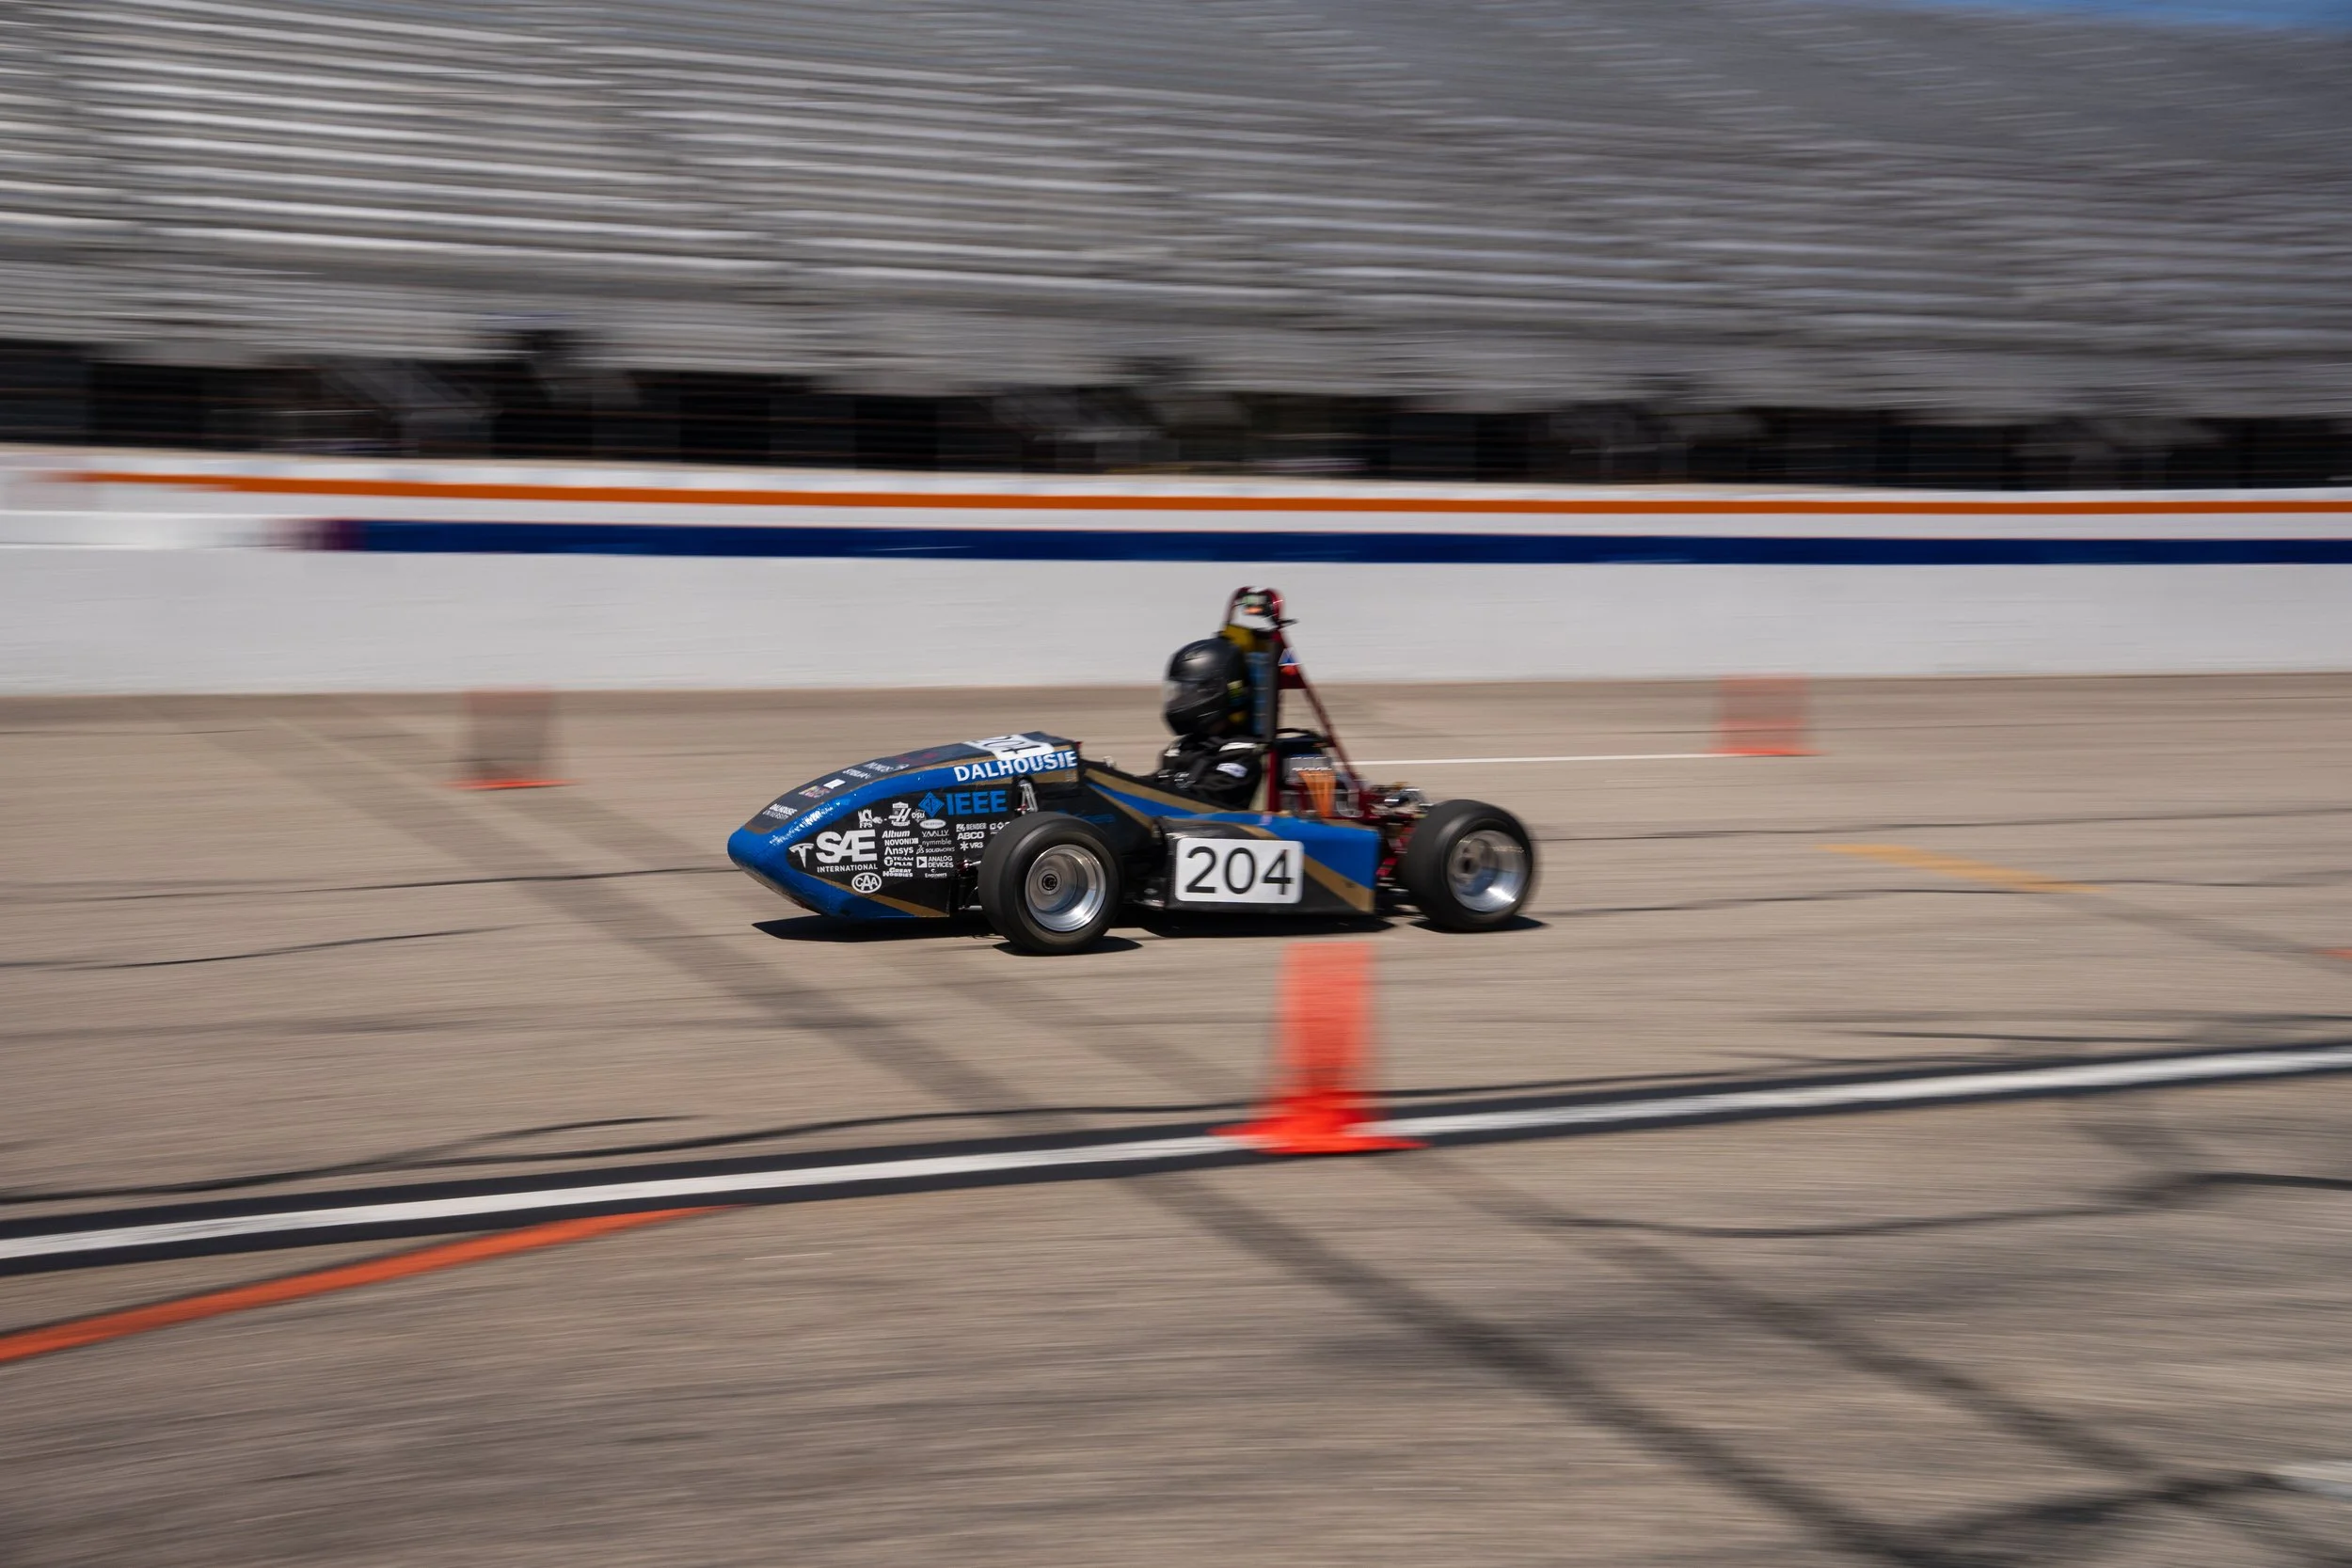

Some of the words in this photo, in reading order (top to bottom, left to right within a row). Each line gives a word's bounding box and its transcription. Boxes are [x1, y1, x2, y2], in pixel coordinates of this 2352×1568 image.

[954, 752, 1078, 782] DALHOUSIE
[946, 791, 1008, 816] IEEE
[882, 830, 911, 838] Altium
[957, 832, 985, 840] ABCO
[816, 830, 878, 863] SAE
[884, 846, 914, 856] Ansys
[969, 841, 984, 849] VR3
[817, 863, 879, 873] INTERNATIONAL
[1184, 846, 1295, 895] 204
[854, 875, 879, 891] CAA
